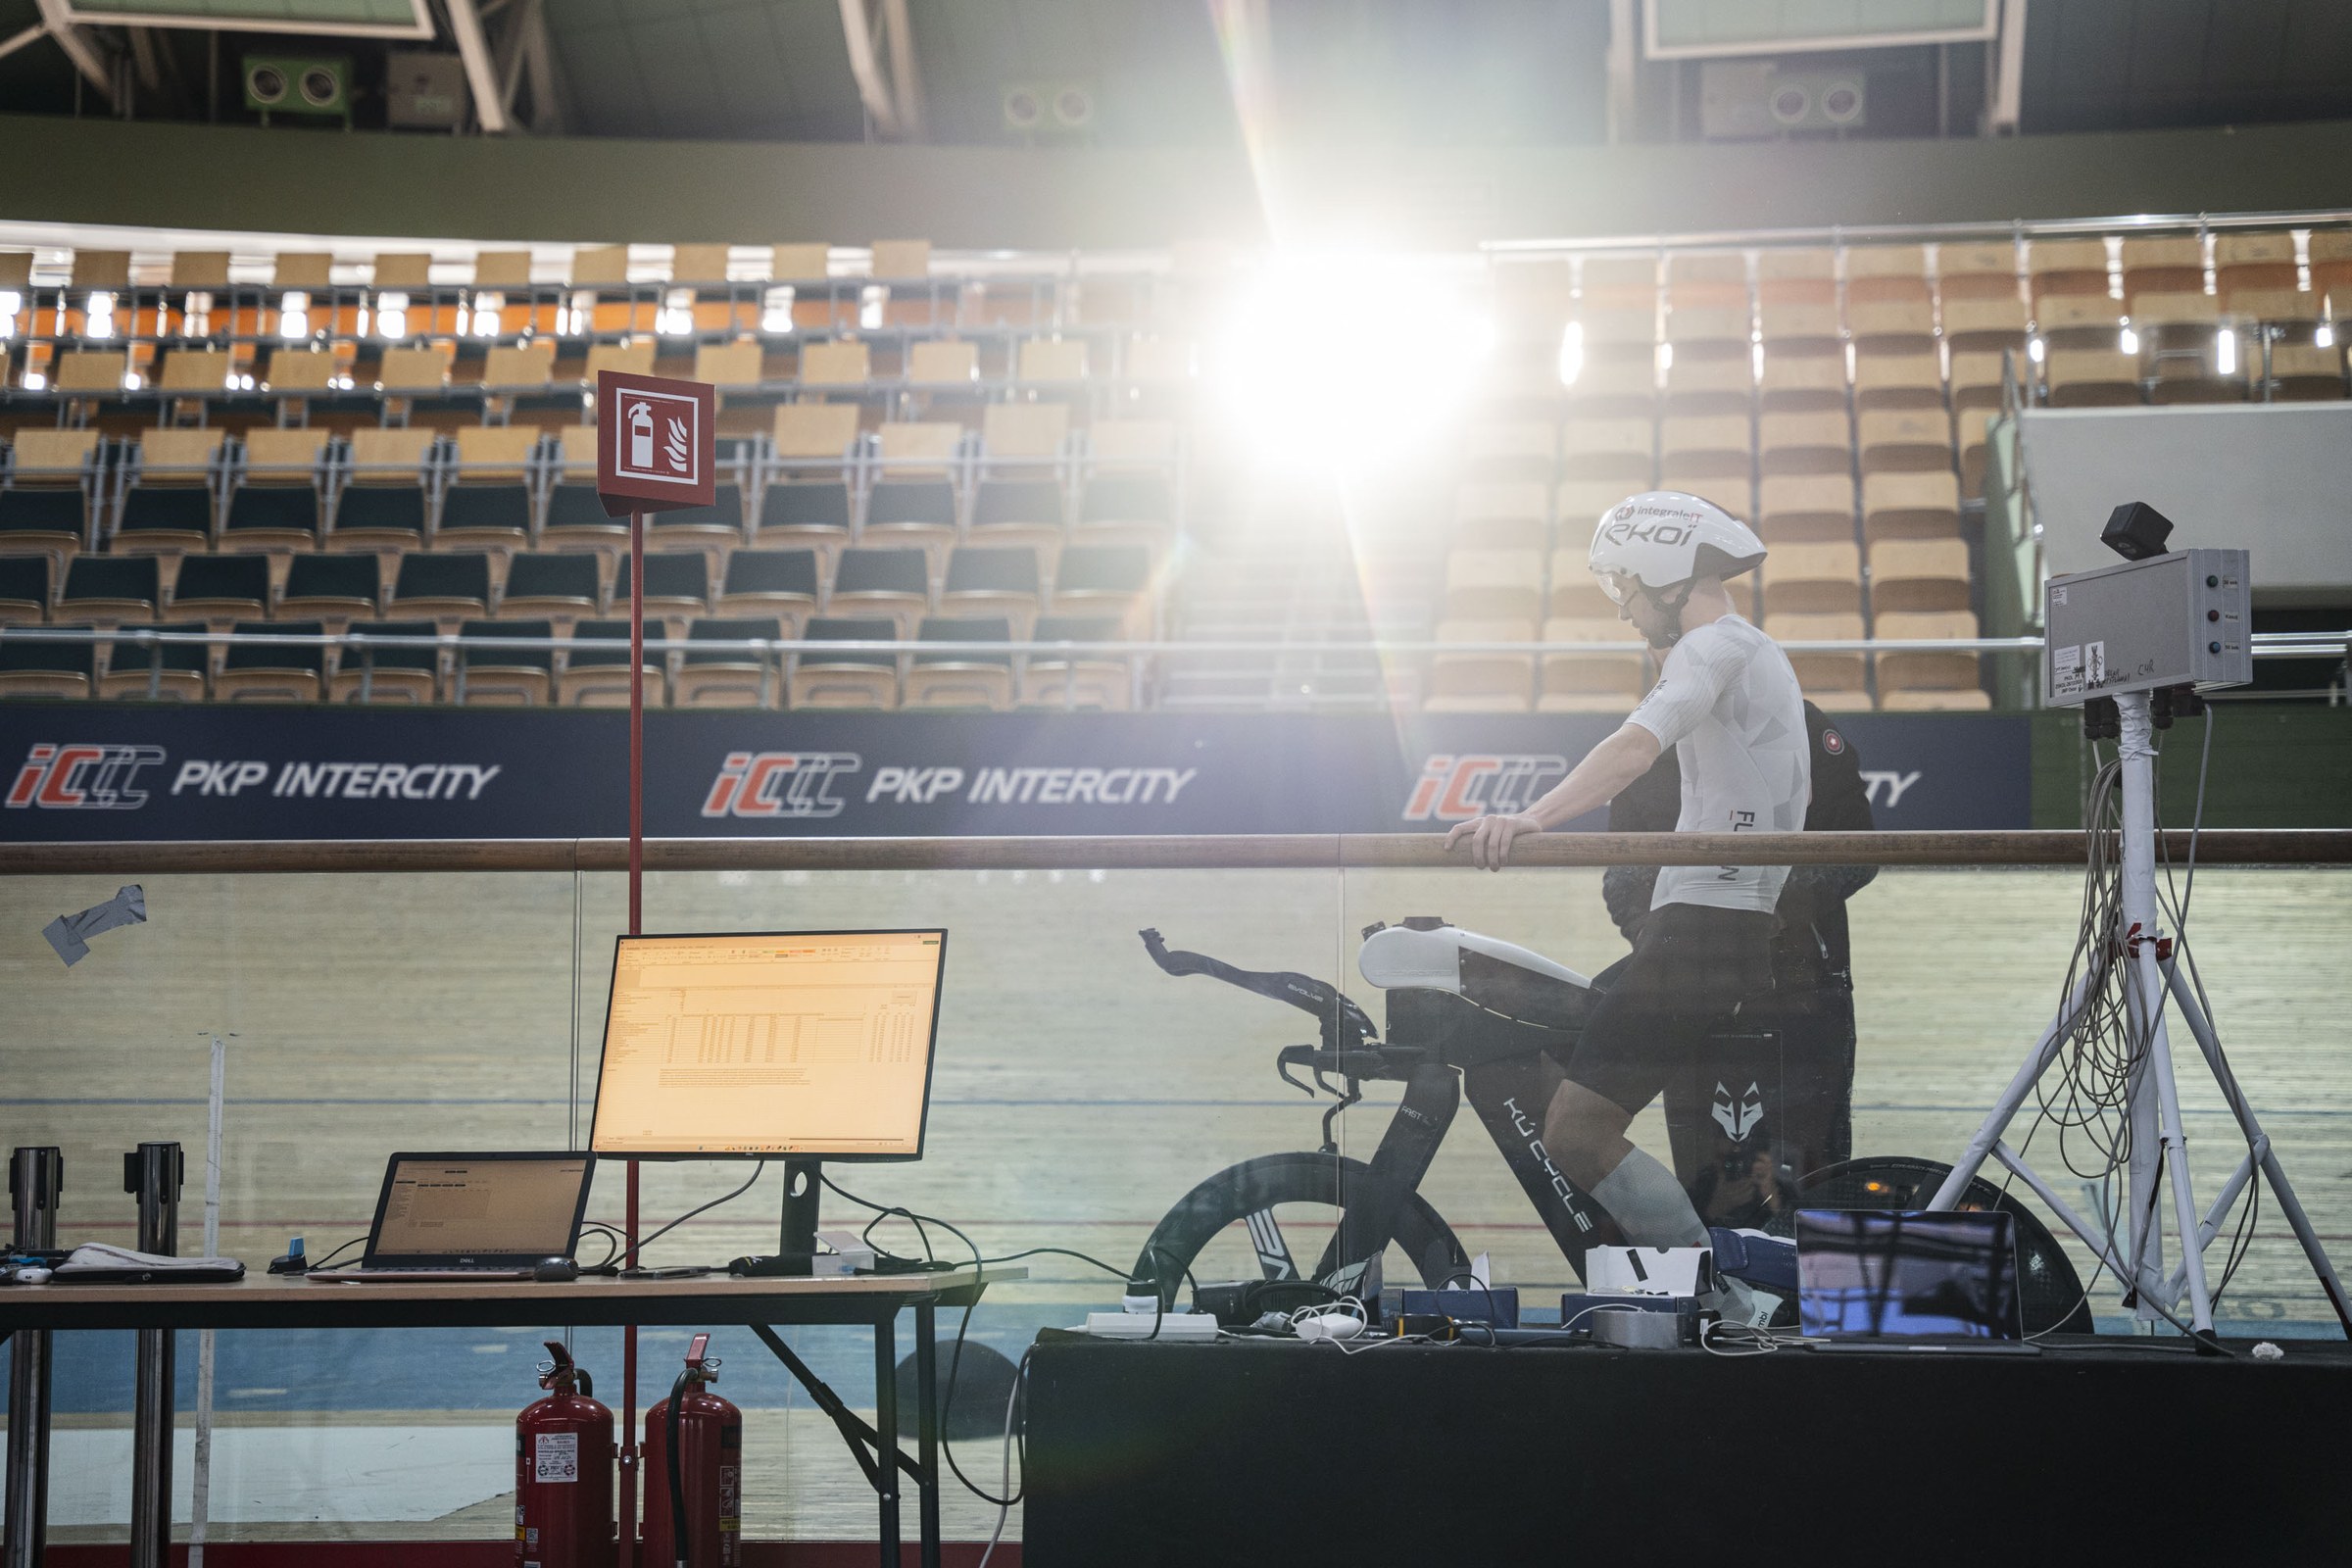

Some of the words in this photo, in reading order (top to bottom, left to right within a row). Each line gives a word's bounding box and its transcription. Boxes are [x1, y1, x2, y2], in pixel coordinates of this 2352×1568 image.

[172, 761, 268, 797] PKP
[273, 762, 500, 800] INTERCITY
[866, 767, 962, 804] PKP
[967, 767, 1198, 805] INTERCITY
